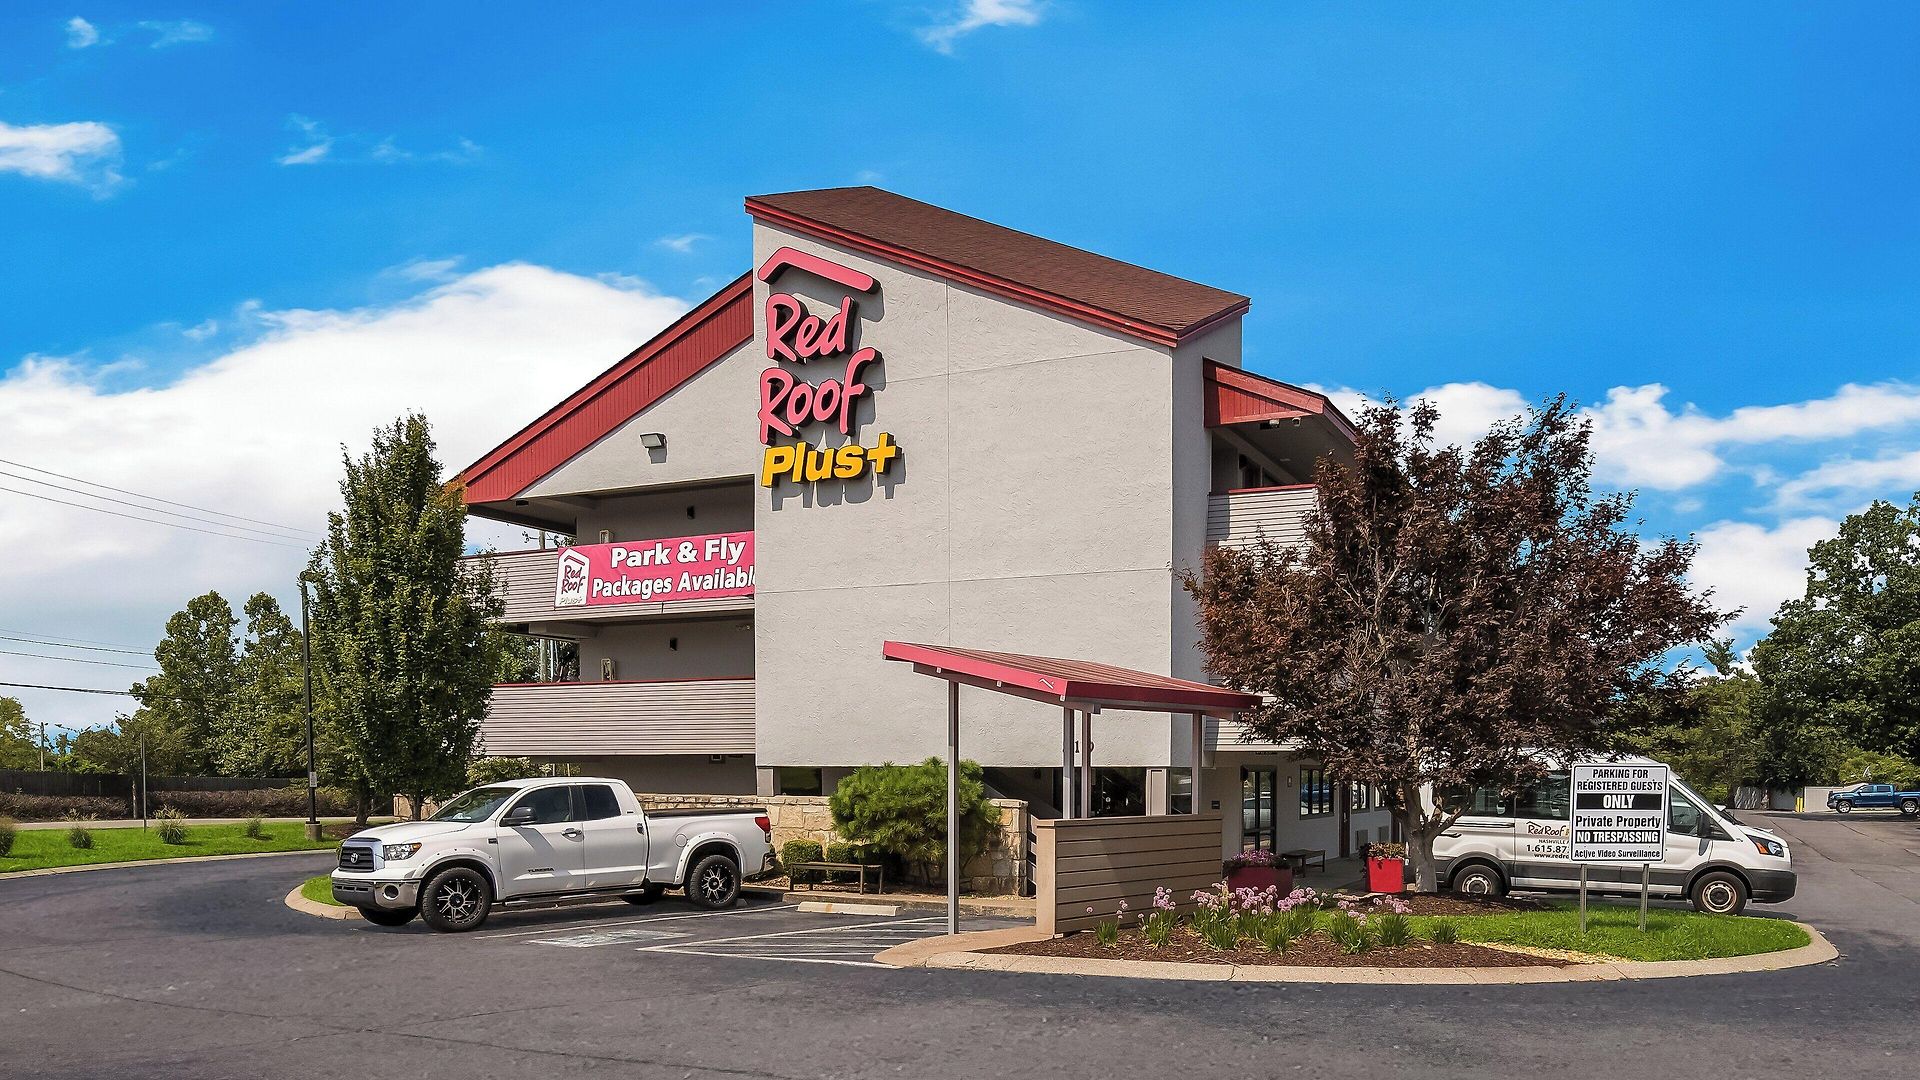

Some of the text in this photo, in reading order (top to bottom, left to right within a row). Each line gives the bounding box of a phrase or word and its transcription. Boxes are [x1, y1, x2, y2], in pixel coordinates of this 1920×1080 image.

[765, 293, 852, 362] Red
[758, 347, 877, 445] Roof
[761, 432, 897, 488] Plus+
[610, 536, 746, 569] Park & Fly
[565, 565, 583, 579] Red
[561, 576, 586, 594] Roof
[591, 574, 673, 600] Packages
[1593, 769, 1648, 778] PARKING FOR
[1577, 781, 1662, 790] REGISTERED GUESTS
[1603, 794, 1635, 808] ONLY
[1576, 816, 1661, 828] Private Property
[1576, 831, 1590, 842] NO
[1592, 831, 1658, 842] TRESPASSING
[1574, 850, 1596, 858] Active
